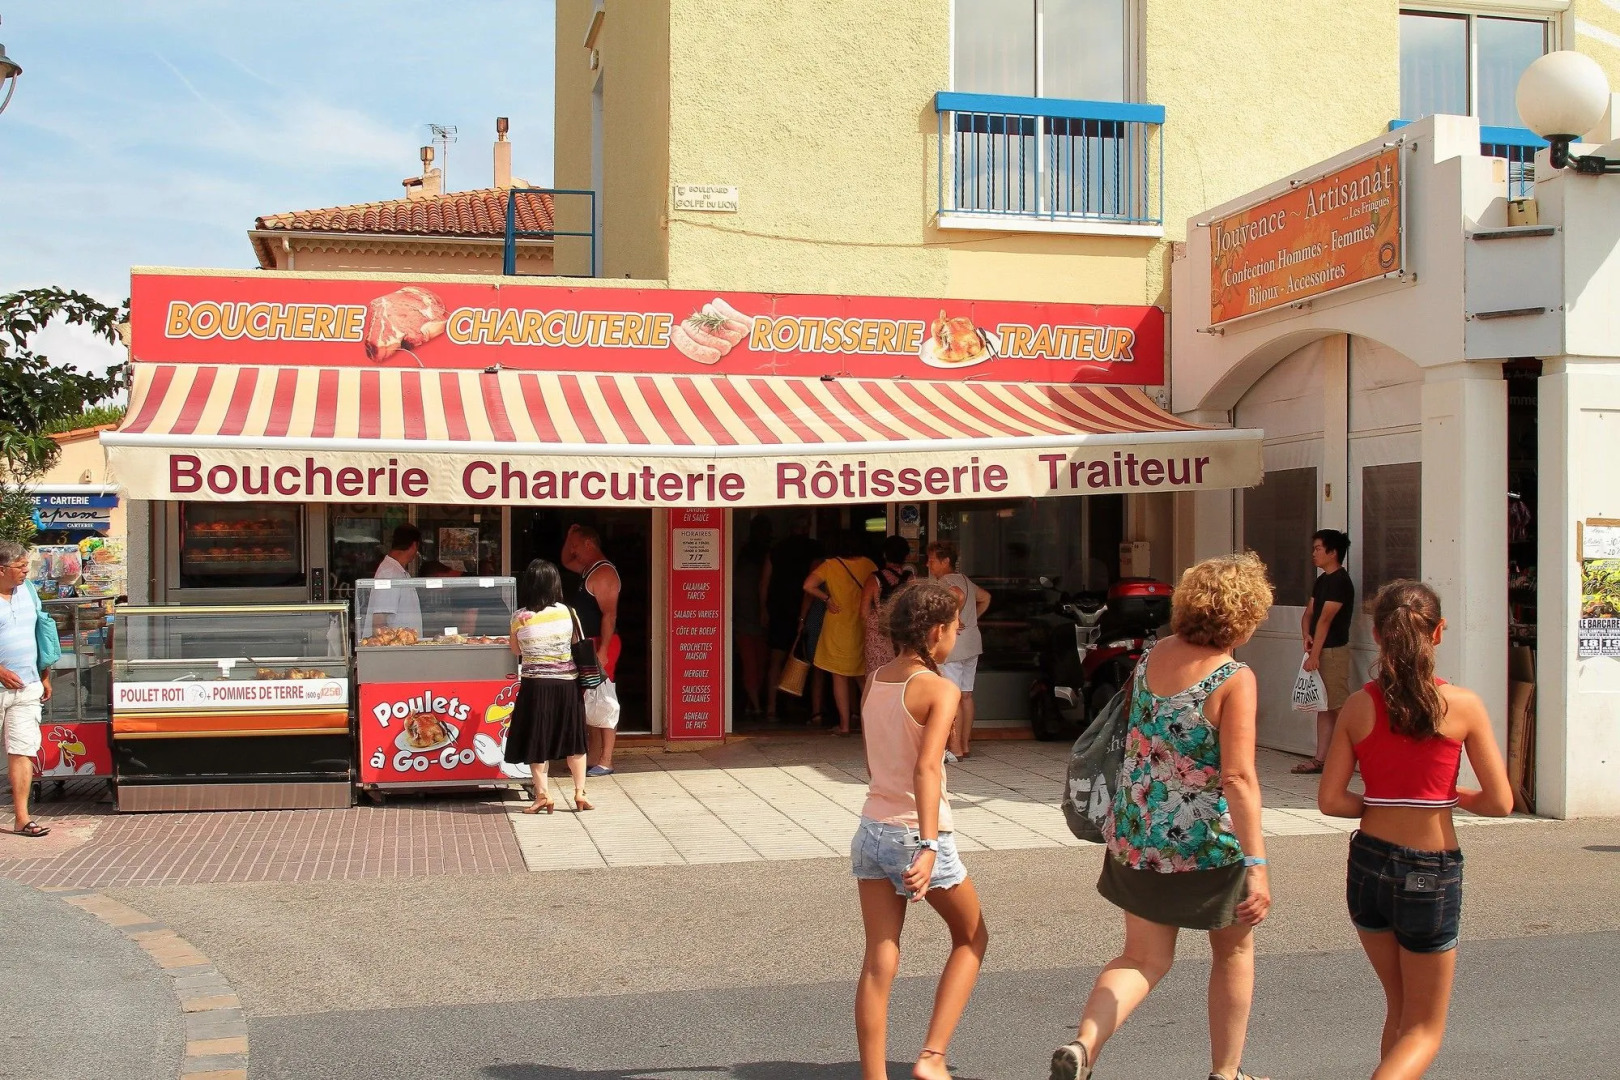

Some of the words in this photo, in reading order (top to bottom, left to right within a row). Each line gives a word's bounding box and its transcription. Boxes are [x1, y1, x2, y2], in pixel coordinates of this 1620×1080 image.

[688, 186, 728, 194] BOULEVARD
[676, 200, 704, 208] GOLFE
[718, 201, 737, 210] LION
[1361, 196, 1390, 214] Fringues
[1215, 210, 1286, 261] Jouvence
[1304, 164, 1392, 220] Artisanat
[1225, 258, 1275, 287] Confection
[1278, 241, 1322, 270] Hommes
[1331, 223, 1375, 251] Femmes
[1249, 285, 1279, 307] Bijoux
[1286, 262, 1346, 294] Accessoires
[166, 302, 366, 341] BOUCHERIE
[447, 308, 672, 347] CHARCUTERIE
[749, 316, 924, 354] ROTISSERIE
[998, 325, 1135, 362] TRAITEUR
[169, 454, 429, 497] Boucherie
[462, 461, 745, 501] Charcuterie
[776, 457, 1008, 499] Rôtisserie
[1038, 451, 1209, 490] Traiteur
[50, 497, 89, 505] CARTERIE
[693, 514, 709, 522] SAUCE
[682, 582, 710, 591] CALAMARS
[687, 592, 706, 600] FARCIS
[674, 610, 697, 618] SALADES
[1579, 619, 1586, 628] LE
[676, 626, 689, 636] CÔTE
[690, 627, 698, 636] DE
[699, 626, 717, 635] BOEUF
[680, 643, 713, 652] BROCHETTES
[685, 652, 707, 660] MAISON
[684, 670, 710, 678] MERGUEZ
[120, 688, 160, 702] POULET
[161, 688, 184, 702] ROTI
[213, 687, 257, 700] POMMES
[259, 687, 272, 700] DE
[274, 686, 304, 699] TERRE
[682, 685, 711, 694] SAUCISSES
[682, 694, 711, 703] CATALANES
[373, 690, 471, 728] Poulets
[684, 712, 709, 720] AGNEAUX
[685, 721, 692, 729] DE
[694, 721, 707, 729] PAYS
[370, 747, 386, 769] à
[393, 747, 475, 772] Go-Go
